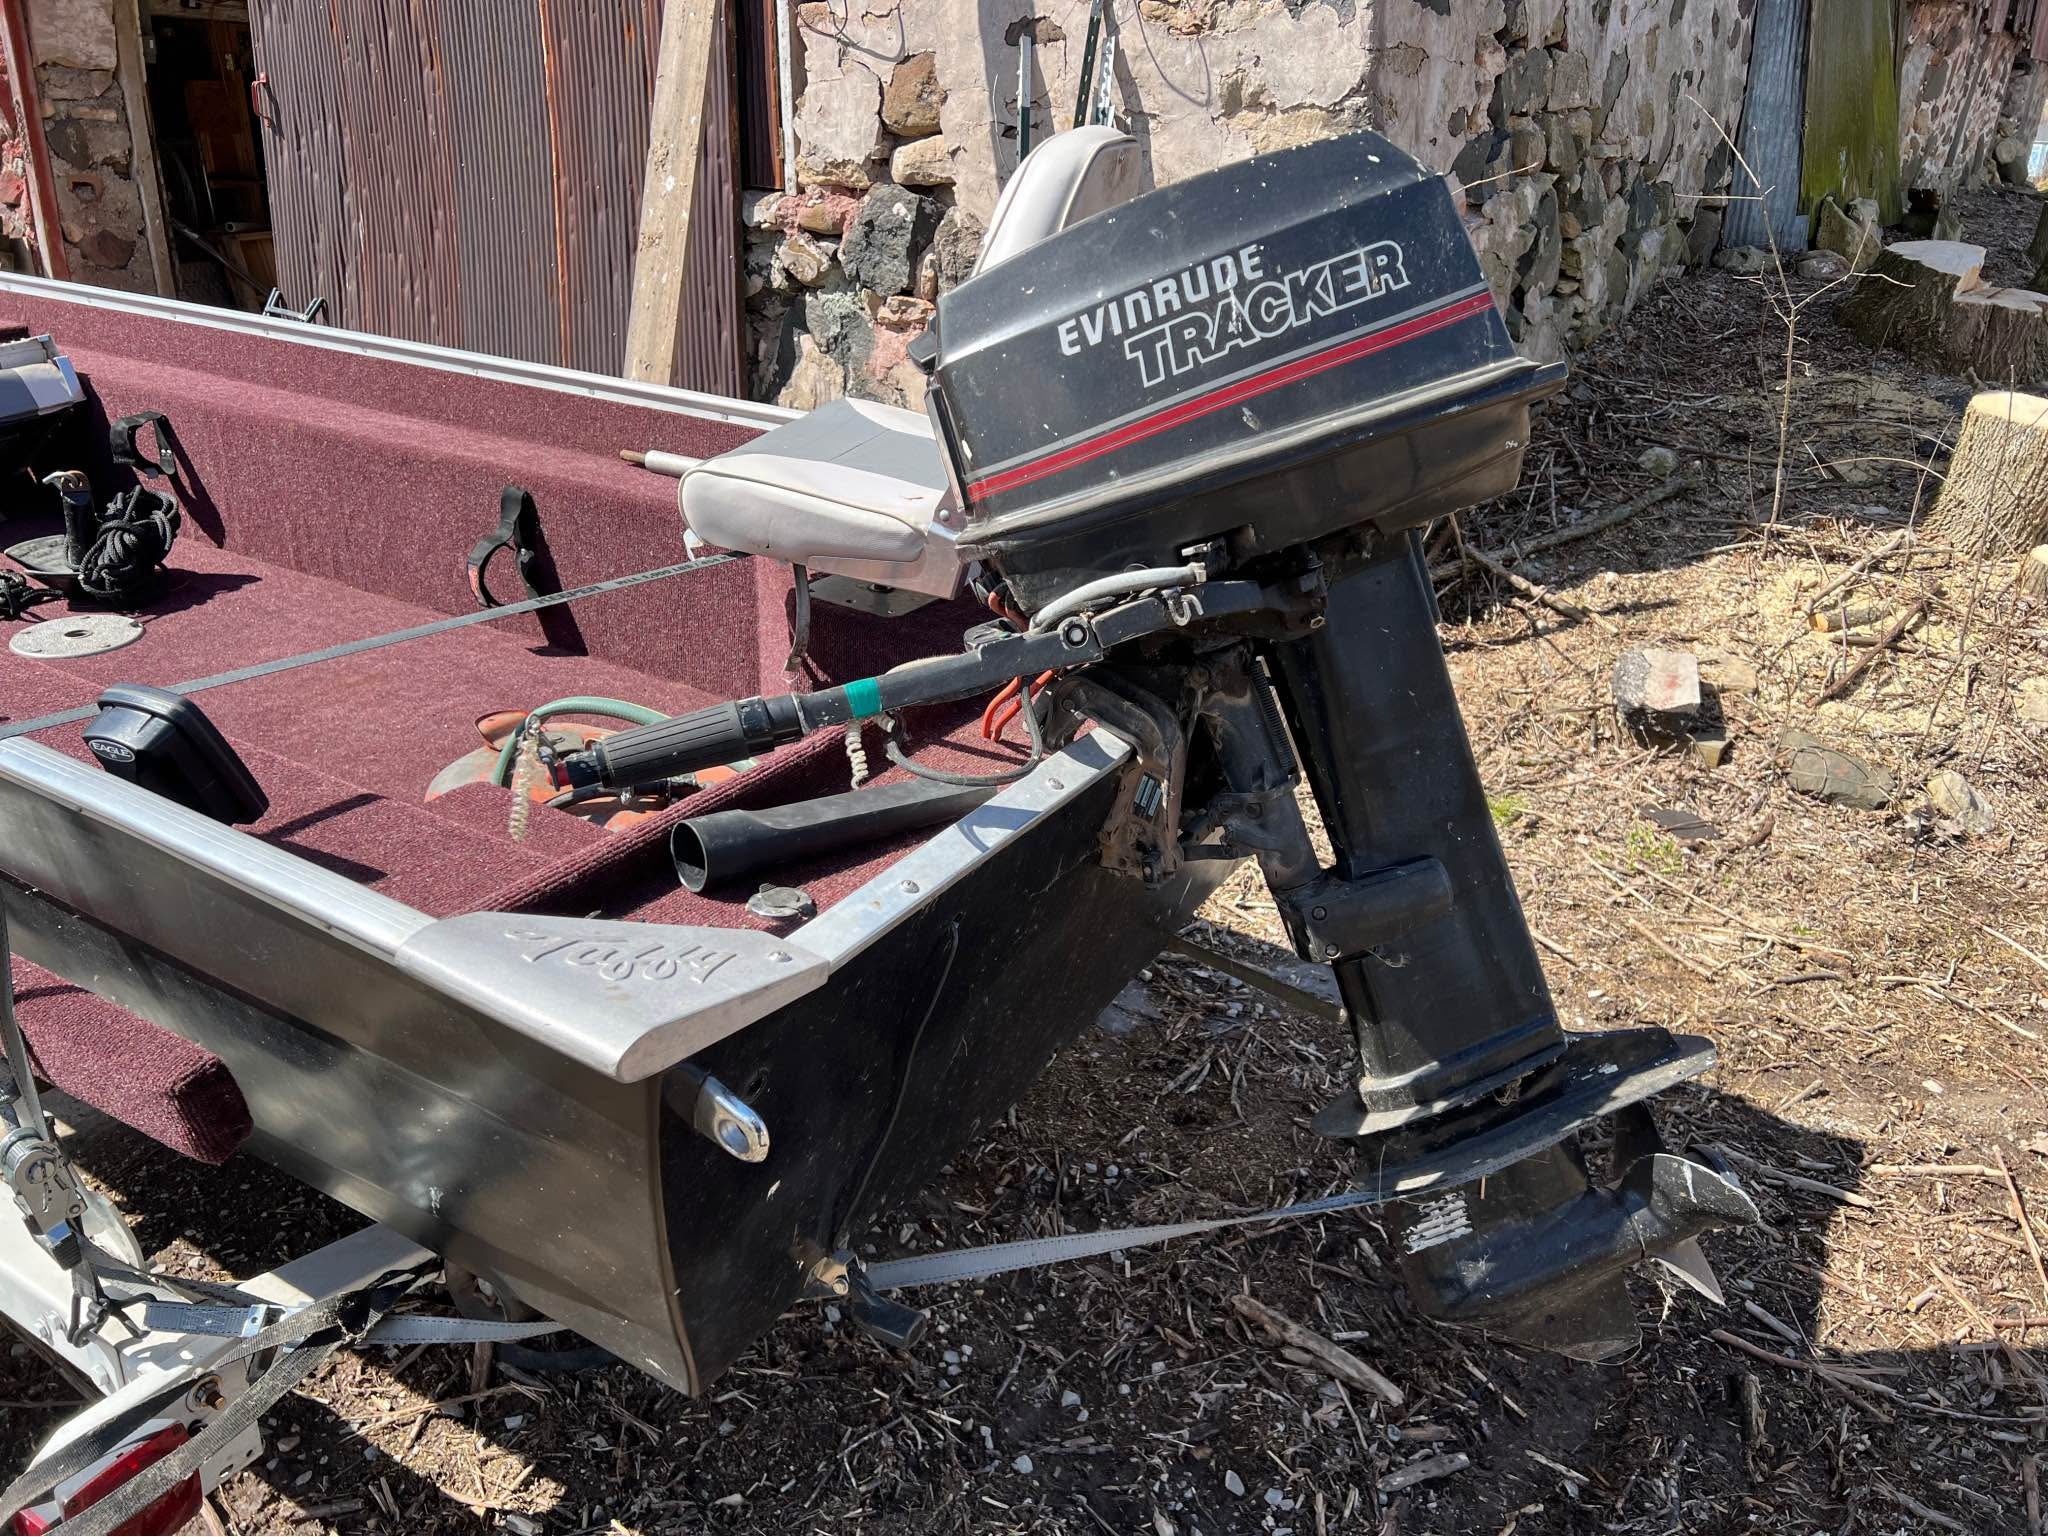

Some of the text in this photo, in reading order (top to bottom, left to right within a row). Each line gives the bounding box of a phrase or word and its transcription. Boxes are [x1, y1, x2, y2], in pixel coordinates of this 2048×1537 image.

[1057, 245, 1264, 356] EVINRUDE
[1124, 240, 1411, 388] TRACKER
[92, 742, 131, 758] EAGLE
